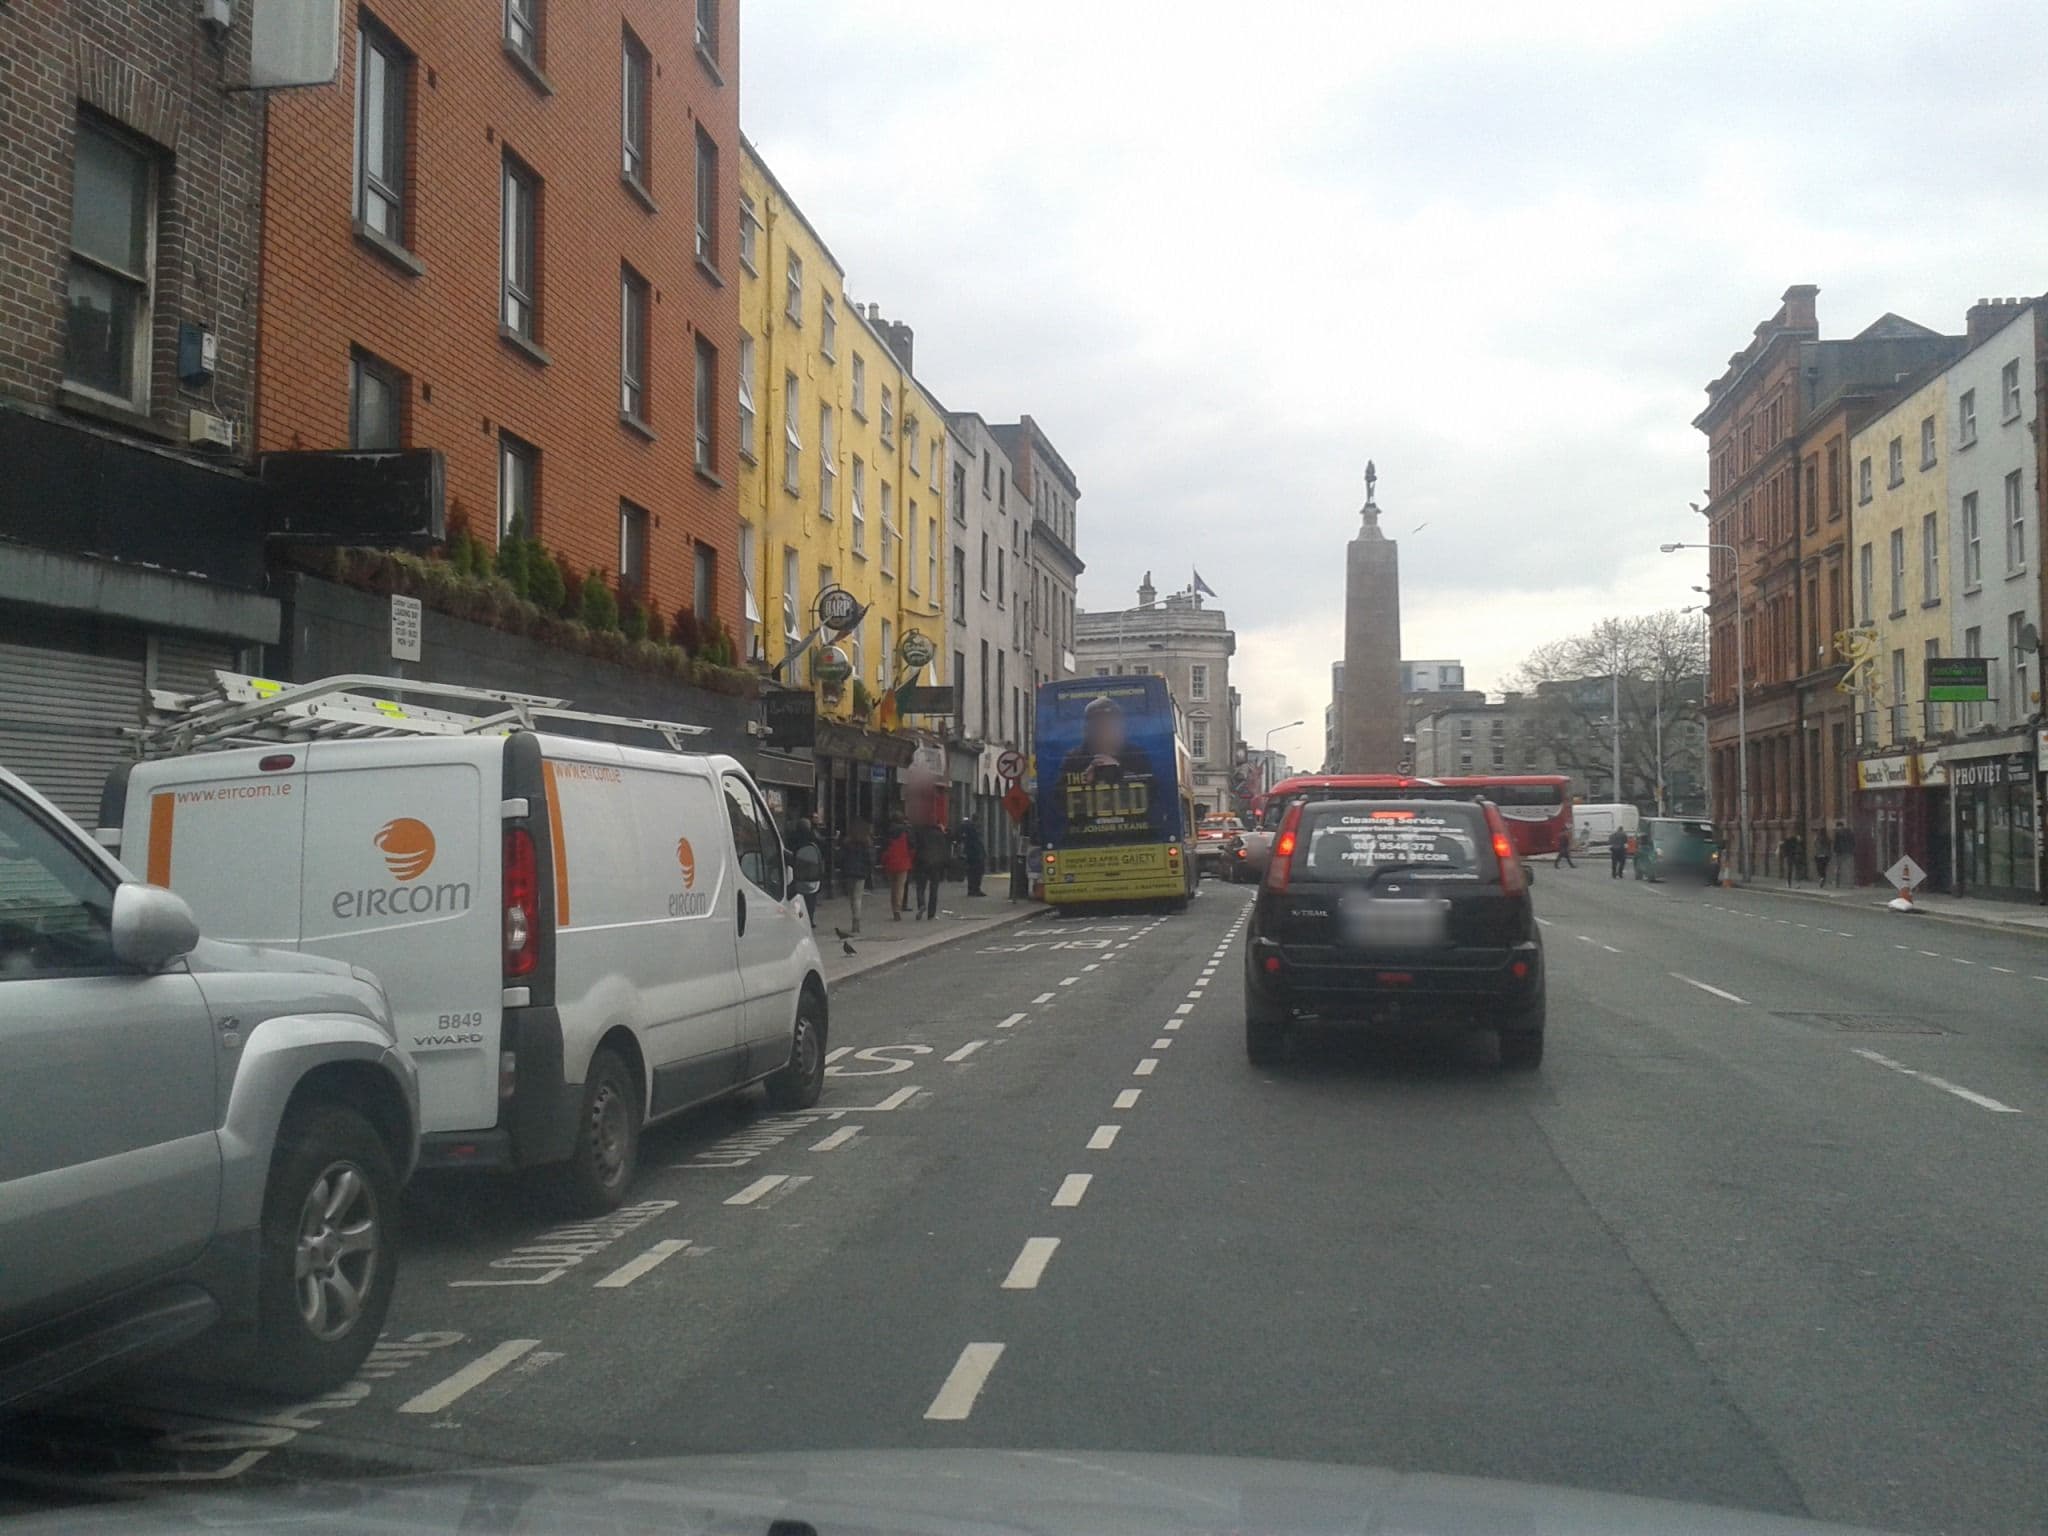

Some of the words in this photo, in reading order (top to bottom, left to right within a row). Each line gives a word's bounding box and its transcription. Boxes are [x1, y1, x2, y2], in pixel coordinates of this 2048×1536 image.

[554, 762, 622, 784] www.eircom.ie
[1066, 772, 1088, 785] THE
[177, 783, 292, 803] www.eircom.ie
[1066, 783, 1147, 819] FIELD
[1341, 816, 1395, 826] Cleaning
[1398, 817, 1446, 825] Service
[332, 881, 471, 920] eircom
[668, 892, 706, 916] eircom
[438, 1012, 482, 1030] B849
